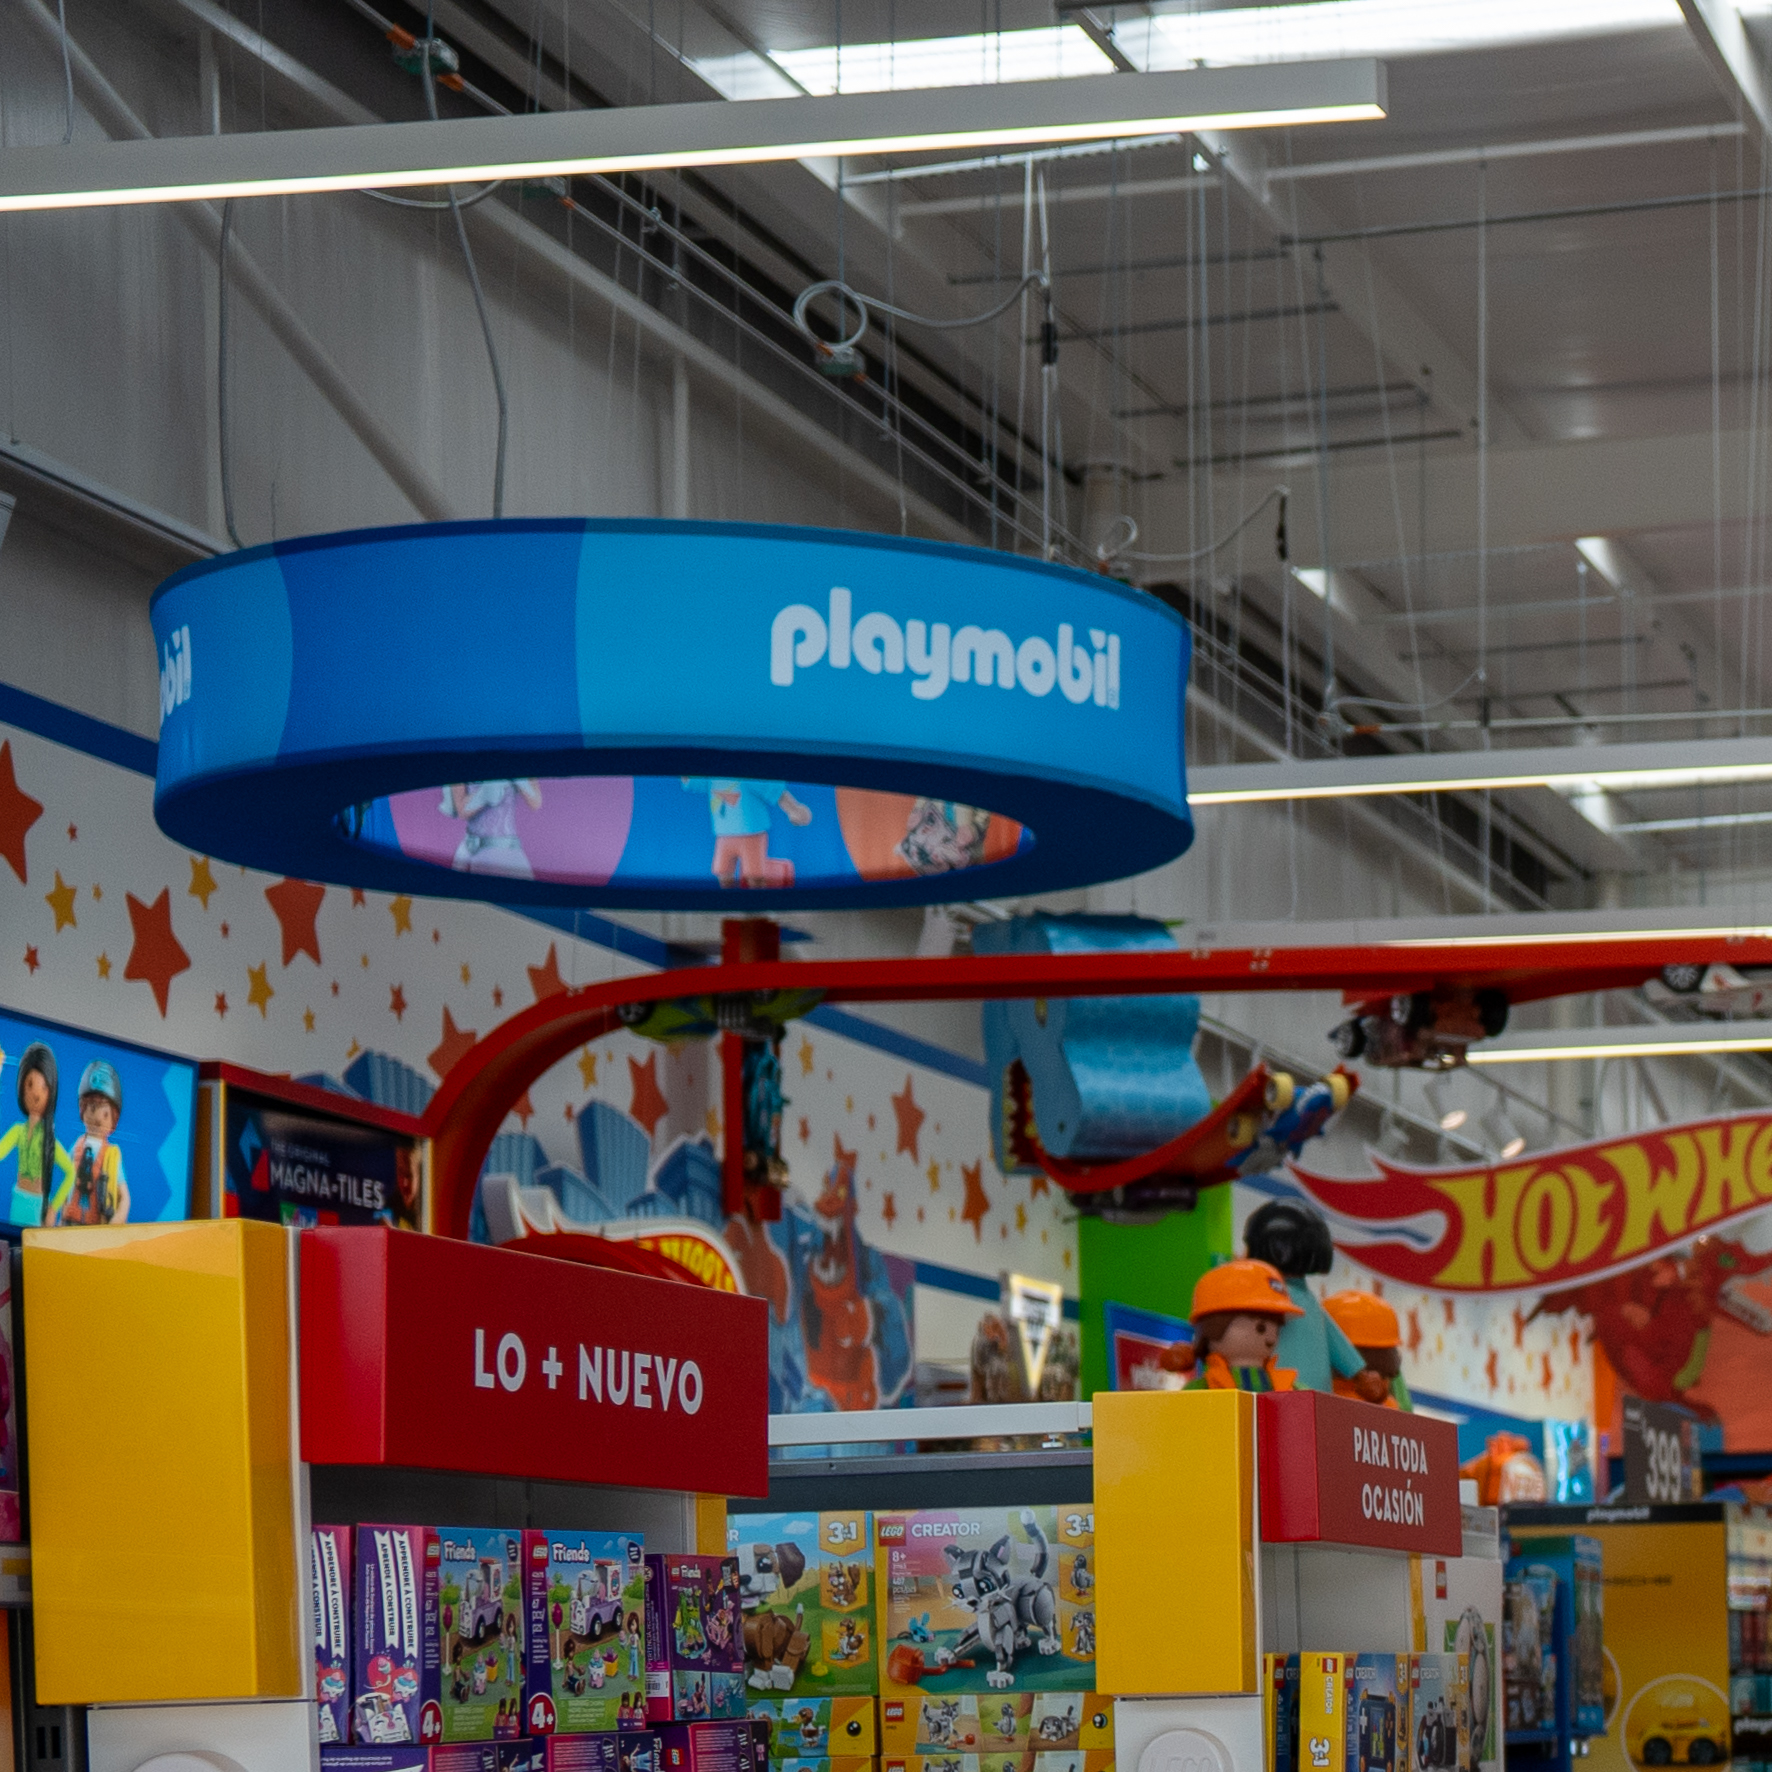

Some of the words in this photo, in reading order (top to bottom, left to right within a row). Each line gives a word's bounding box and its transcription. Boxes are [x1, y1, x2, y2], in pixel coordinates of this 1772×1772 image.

[771, 586, 1121, 710] playmobil
[1428, 1160, 1612, 1288] HOT
[474, 1326, 527, 1393] LO
[541, 1346, 565, 1391] +
[577, 1342, 705, 1417] NUEVO
[1353, 1425, 1390, 1469] PARA
[1391, 1433, 1429, 1477] TODA
[1361, 1478, 1426, 1529] OCASIÓN
[443, 1537, 477, 1563] Friends
[551, 1540, 591, 1564] Friends
[911, 1522, 981, 1538] CREATOR
